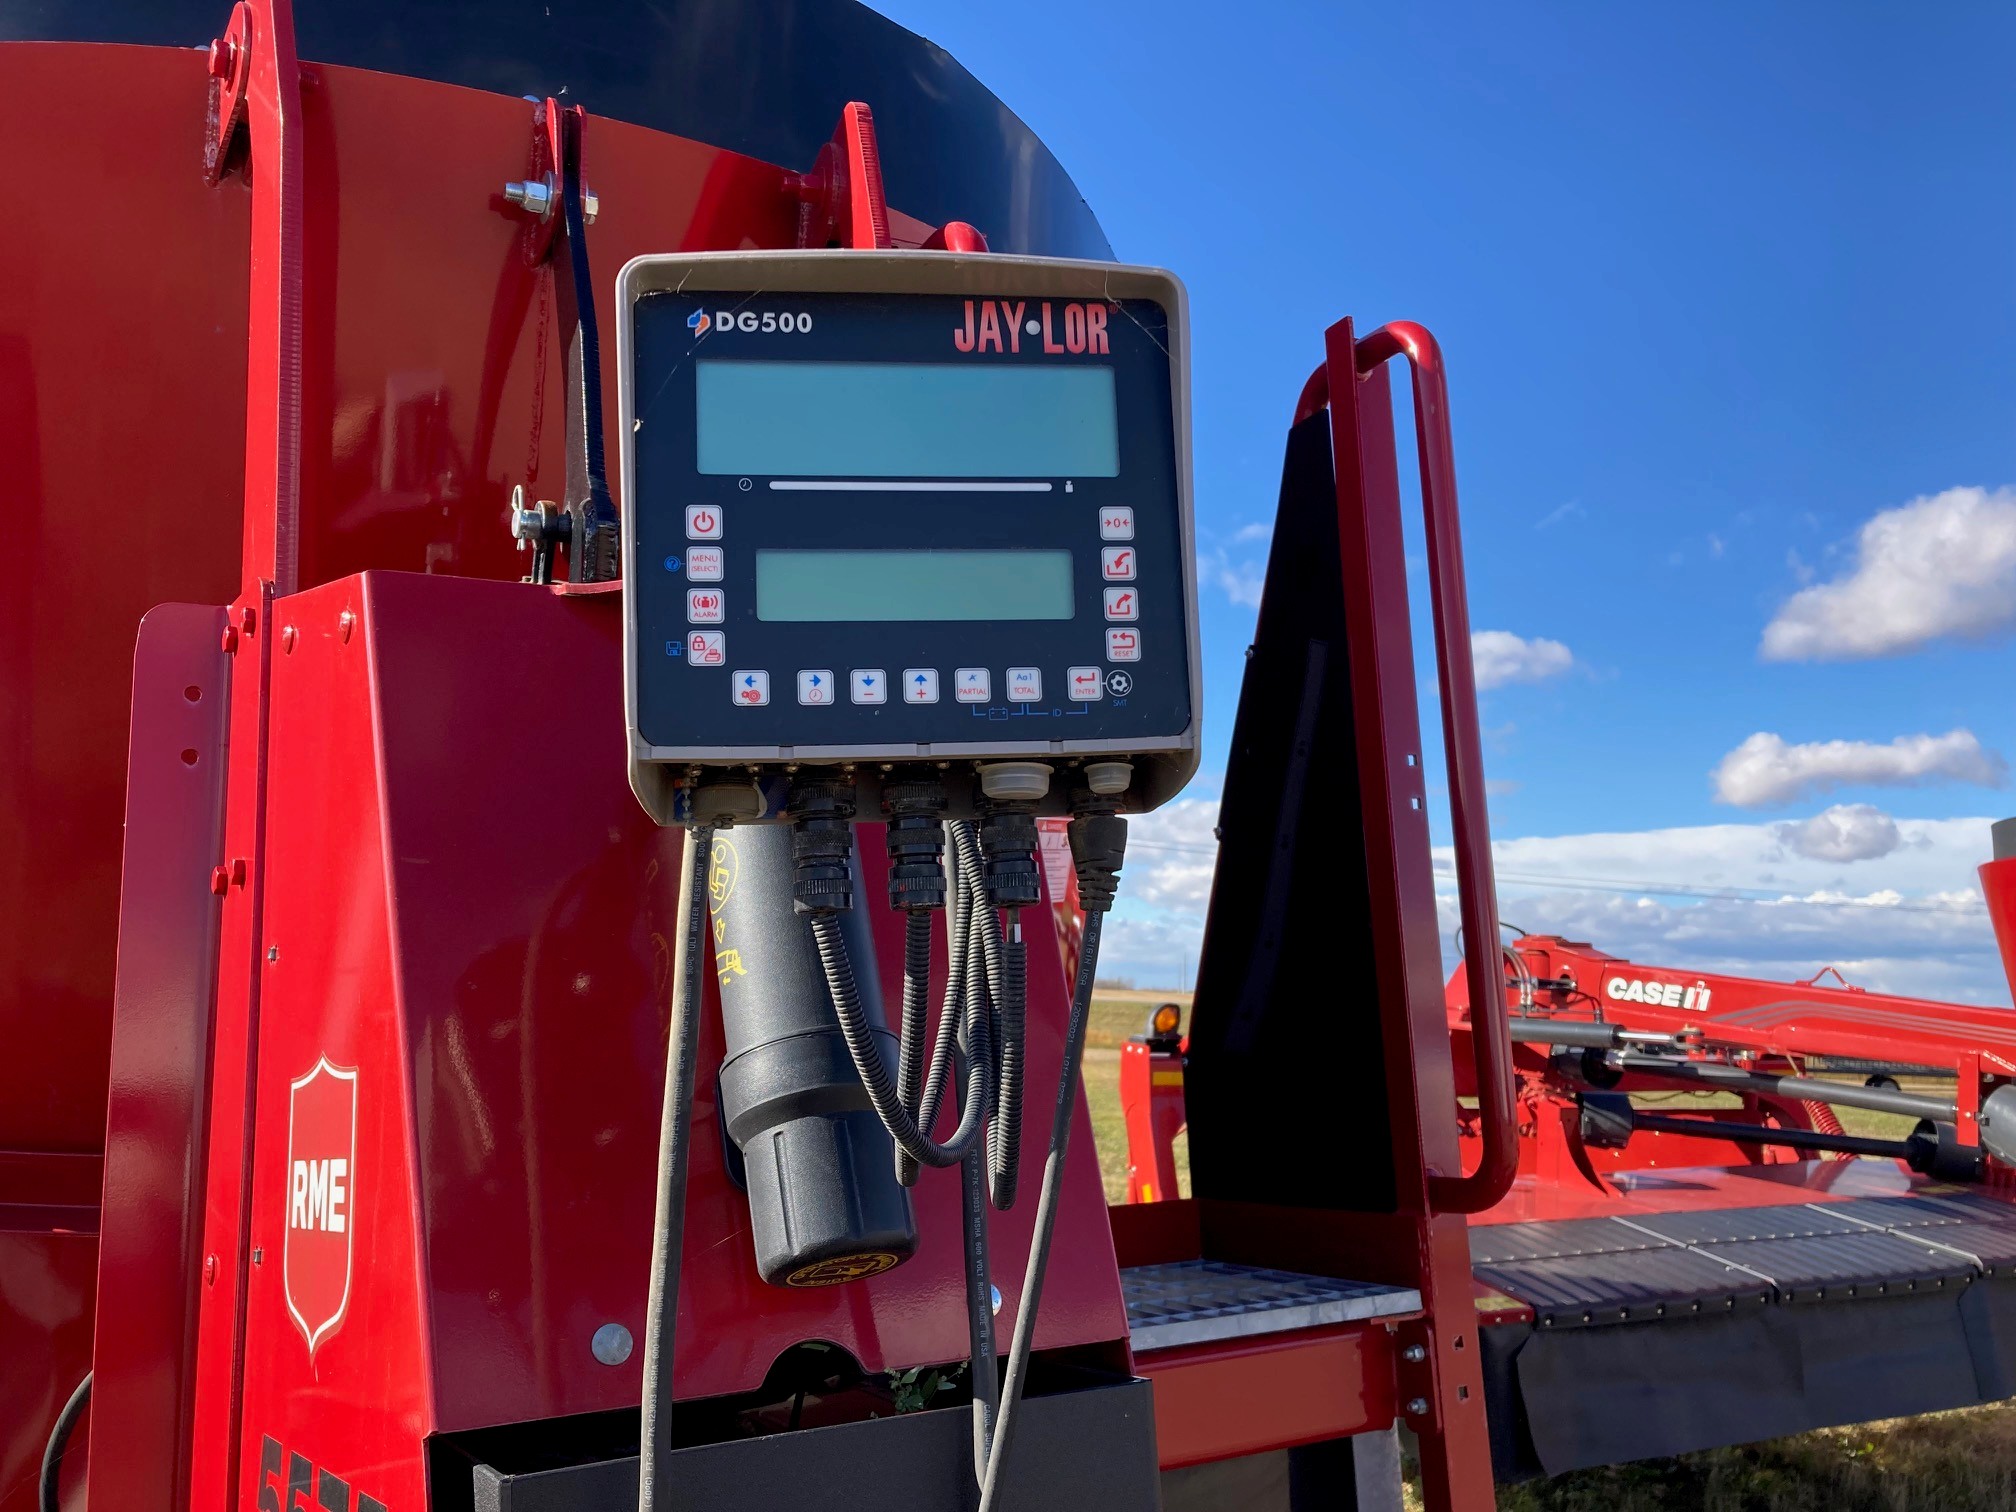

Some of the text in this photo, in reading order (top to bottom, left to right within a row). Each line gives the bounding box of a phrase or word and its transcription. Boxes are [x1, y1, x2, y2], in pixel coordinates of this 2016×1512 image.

[716, 311, 812, 334] DG500
[691, 554, 718, 562] MENU
[691, 564, 719, 572] (SELECT)
[959, 687, 988, 695] PARTIAL
[1052, 709, 1062, 717] ID
[697, 841, 706, 858] SOO
[694, 862, 704, 902] RESISTANT
[690, 906, 700, 932] WATER
[1091, 911, 1100, 927] OHS
[688, 937, 697, 954] (UL)
[1084, 932, 1097, 965] ORIGIN
[1080, 969, 1090, 986] USA
[1607, 977, 1683, 1008] CASE
[670, 1119, 680, 1146] SUPER
[970, 1148, 978, 1165] FT-2
[291, 1158, 348, 1233] RME
[661, 1228, 670, 1244] USA
[973, 1217, 982, 1238] MSHA
[660, 1249, 668, 1259] IN
[658, 1264, 667, 1287] MADE
[976, 1259, 984, 1278] VOLT
[978, 1305, 986, 1326] MADE
[653, 1318, 662, 1339] VOLT
[980, 1330, 987, 1338] IN
[652, 1344, 660, 1359] 600
[980, 1342, 989, 1358] USA
[651, 1364, 659, 1388] MSHA
[647, 1394, 658, 1447] P-7K-123033
[983, 1404, 991, 1428] CAROL
[646, 1452, 654, 1471] FT-2
